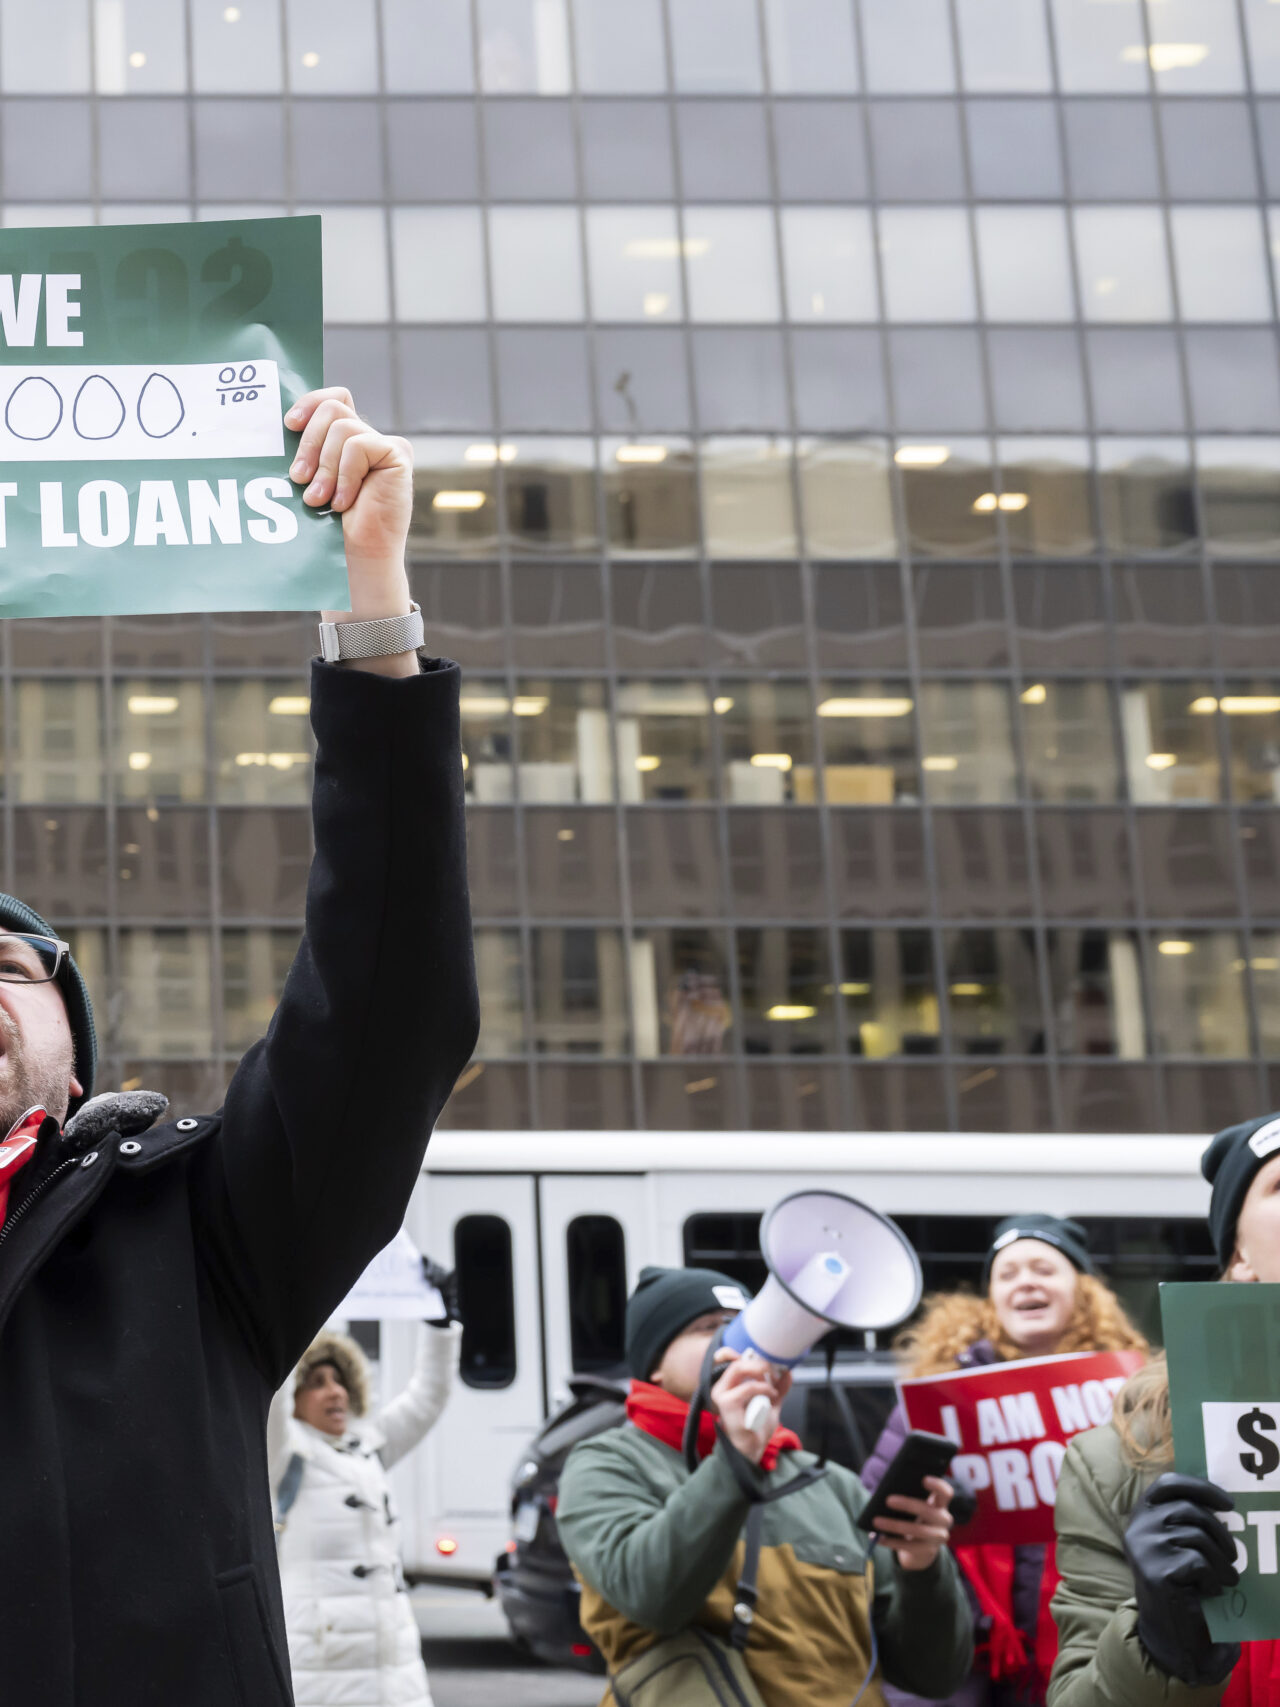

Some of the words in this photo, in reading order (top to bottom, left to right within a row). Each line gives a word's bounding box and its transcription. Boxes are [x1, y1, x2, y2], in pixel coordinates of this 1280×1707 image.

[39, 476, 300, 549] LOANS
[976, 1391, 1046, 1447] AM
[1237, 1407, 1280, 1481] $
[950, 1440, 1068, 1512] PRO
